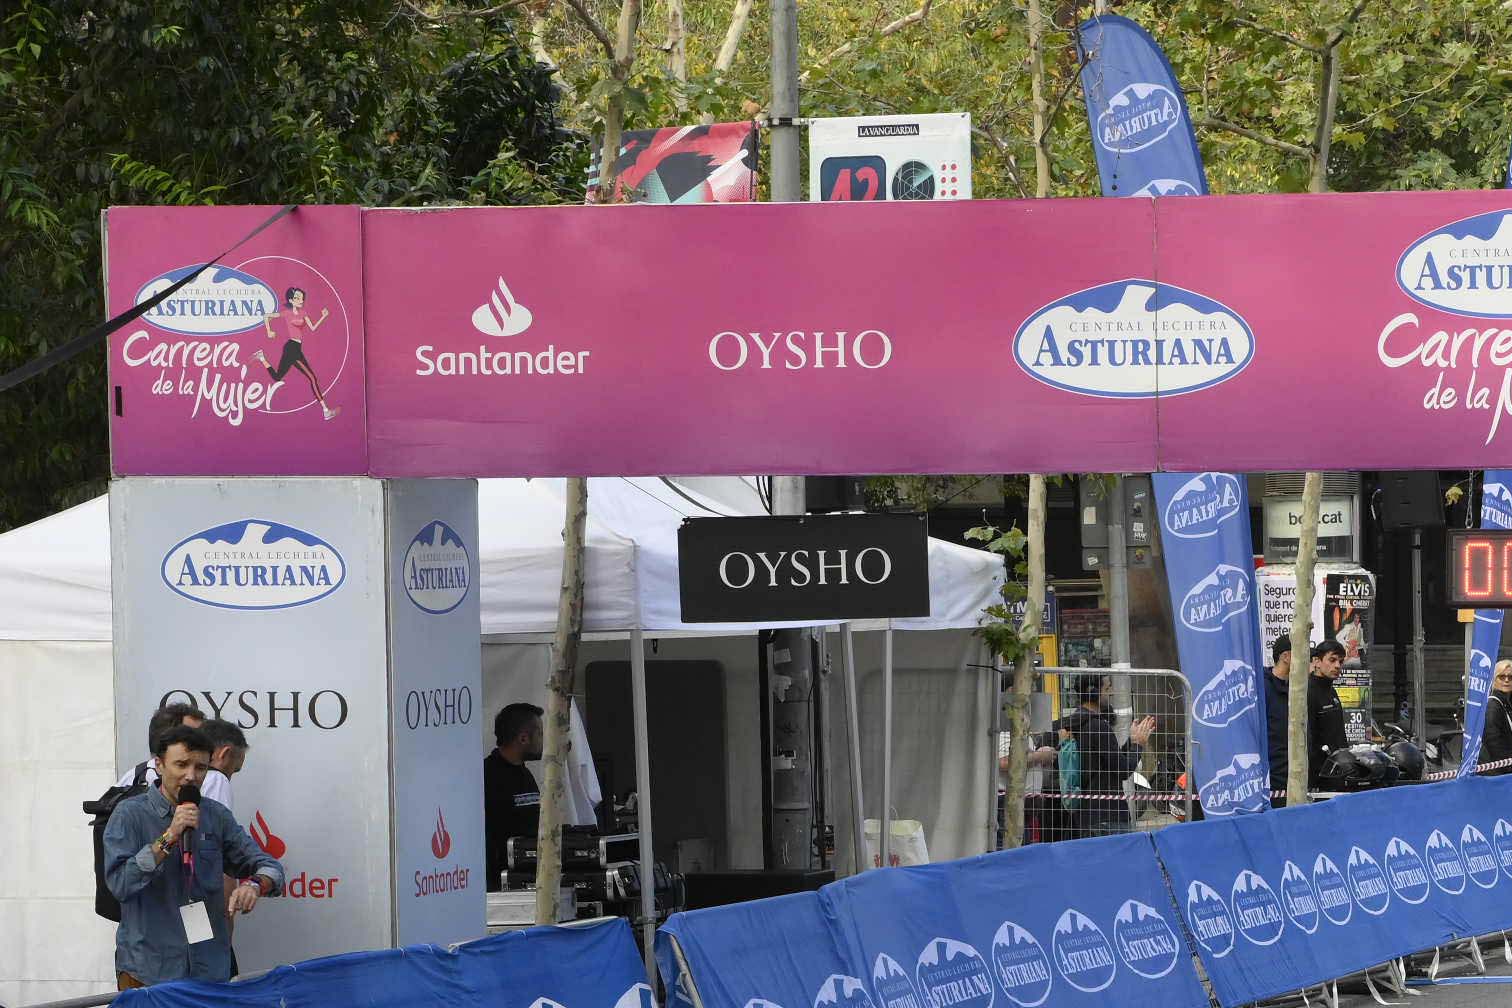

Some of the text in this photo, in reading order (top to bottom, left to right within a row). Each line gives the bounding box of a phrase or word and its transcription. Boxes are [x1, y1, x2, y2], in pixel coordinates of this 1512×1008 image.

[1069, 320, 1228, 333] CENTRAL LECHERA
[122, 330, 240, 368] Carrera
[415, 344, 590, 376] Santander
[707, 329, 893, 371] OYSHO
[1032, 324, 1236, 367] ASTURIANA
[151, 369, 195, 396] de la
[191, 364, 286, 427] Mujer
[1423, 371, 1491, 410] de la
[176, 552, 333, 587] ASTURIANA
[408, 556, 466, 591] ASTURIANA
[719, 546, 892, 590] OYSHO
[1264, 600, 1282, 612] que
[1339, 583, 1370, 596] ELVIS
[1265, 612, 1296, 625] quiere
[405, 686, 472, 730] OYSHO
[1350, 712, 1362, 724] 30
[414, 864, 470, 898] Santander
